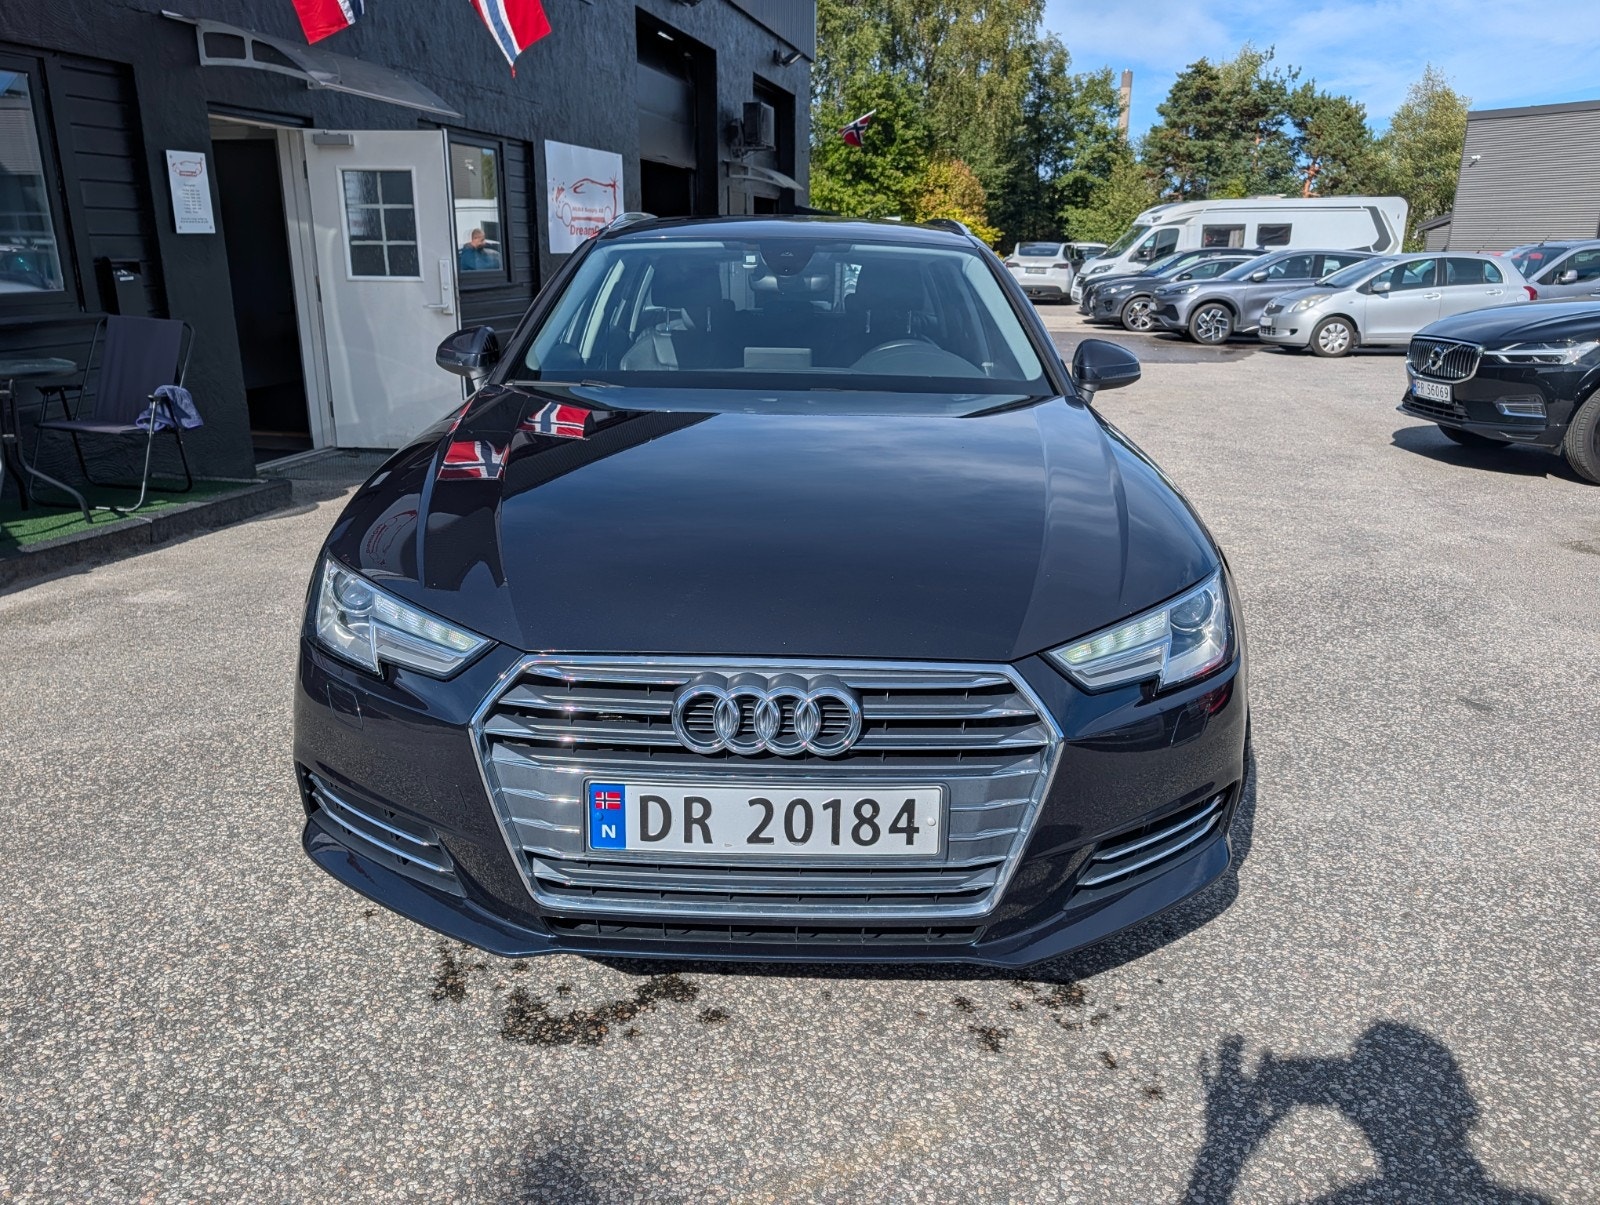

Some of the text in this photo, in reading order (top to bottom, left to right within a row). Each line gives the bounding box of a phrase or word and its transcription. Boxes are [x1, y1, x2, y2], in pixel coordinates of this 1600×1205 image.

[1427, 384, 1449, 399] 56069
[639, 795, 920, 847] DR 20184
[602, 824, 616, 838] N
